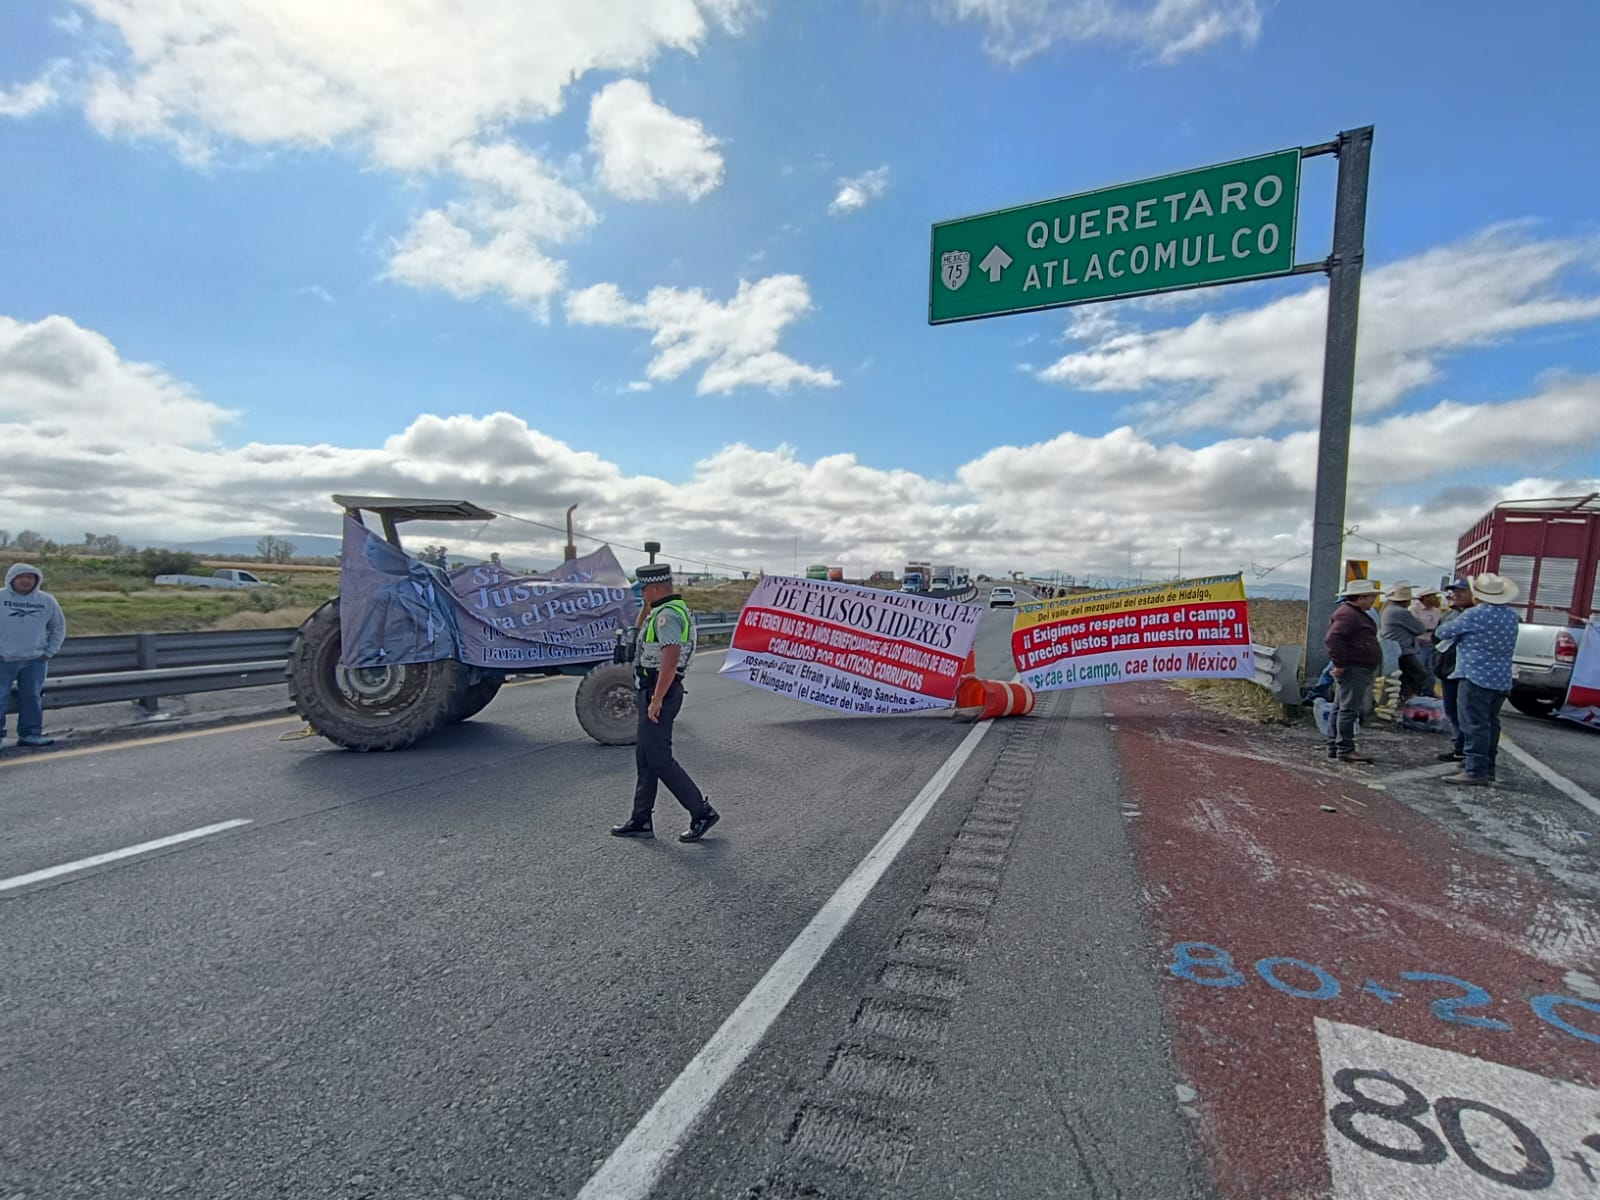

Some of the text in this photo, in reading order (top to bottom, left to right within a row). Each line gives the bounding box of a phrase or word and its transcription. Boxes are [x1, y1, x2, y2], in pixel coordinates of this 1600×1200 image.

[1026, 175, 1283, 249] QUERETARO
[943, 252, 969, 263] MEXICO
[948, 264, 963, 280] 75
[1023, 223, 1280, 293] ATLACOMULCO
[951, 280, 957, 288] D
[521, 603, 542, 626] el
[544, 586, 626, 619] Pueblo
[771, 586, 802, 610] DE
[801, 590, 878, 630] FALSOS
[1037, 588, 1212, 622] Del valle del mezquital del estado de Hidalgo,
[1089, 614, 1137, 632] respeto
[1140, 612, 1170, 629] para
[1173, 607, 1185, 622] el
[1189, 608, 1236, 623] campo
[481, 646, 524, 663] para
[526, 643, 545, 660] el
[887, 642, 903, 661] LOS
[1018, 653, 1026, 669] y
[1071, 635, 1108, 655] justos
[1111, 632, 1140, 649] para
[1143, 626, 1194, 643] nuestro
[768, 636, 816, 661] COBIJADOS
[873, 661, 924, 691] CORRUPTOS
[1045, 671, 1063, 686] cae
[1066, 663, 1077, 681] el
[1079, 662, 1122, 682] campo,
[1124, 658, 1149, 675] cae
[1152, 652, 1182, 673] todo
[1186, 651, 1238, 672] México
[824, 675, 831, 690] y
[830, 674, 851, 692] Julio
[851, 680, 873, 700] Hugo
[839, 695, 853, 710] del
[854, 700, 874, 713] valle
